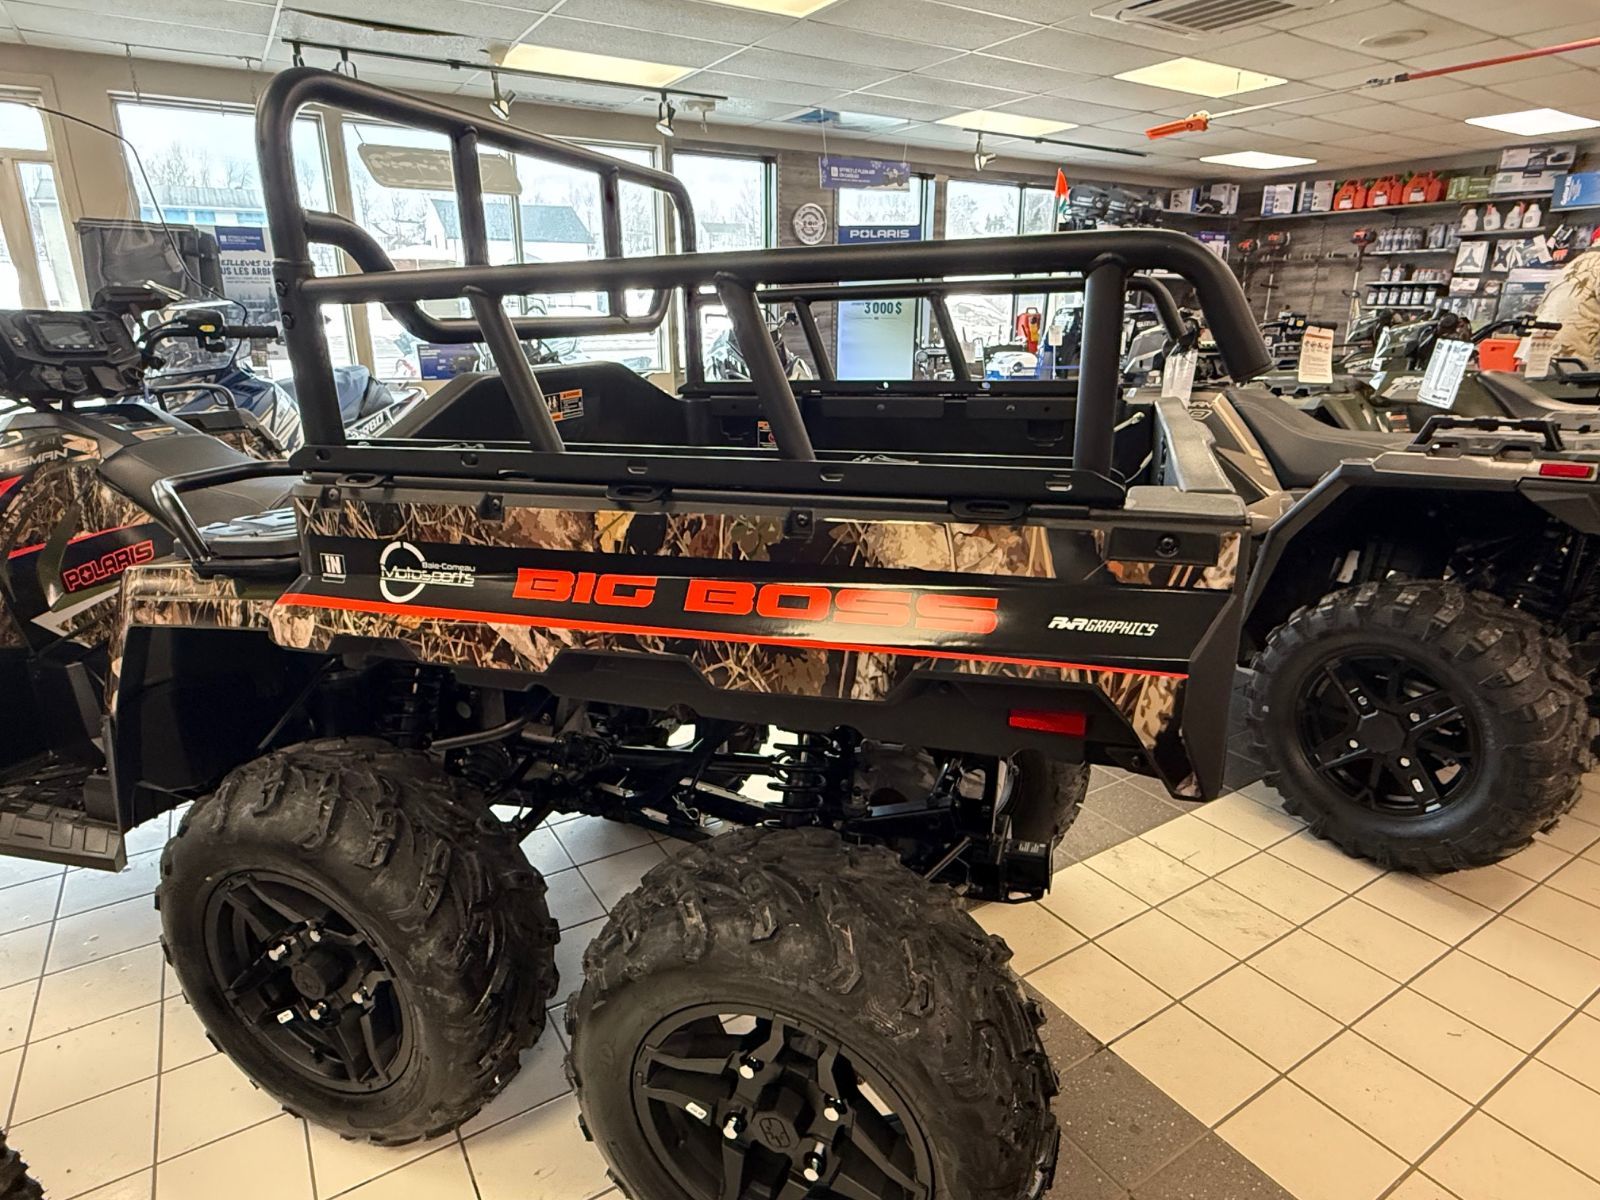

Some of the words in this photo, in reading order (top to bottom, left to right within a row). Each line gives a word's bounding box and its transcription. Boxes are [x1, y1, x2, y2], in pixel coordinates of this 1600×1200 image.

[849, 229, 910, 239] POLARIS
[233, 267, 250, 276] LES
[63, 539, 155, 592] POLARIS
[512, 567, 658, 608] BIG
[684, 578, 999, 635] BOSS
